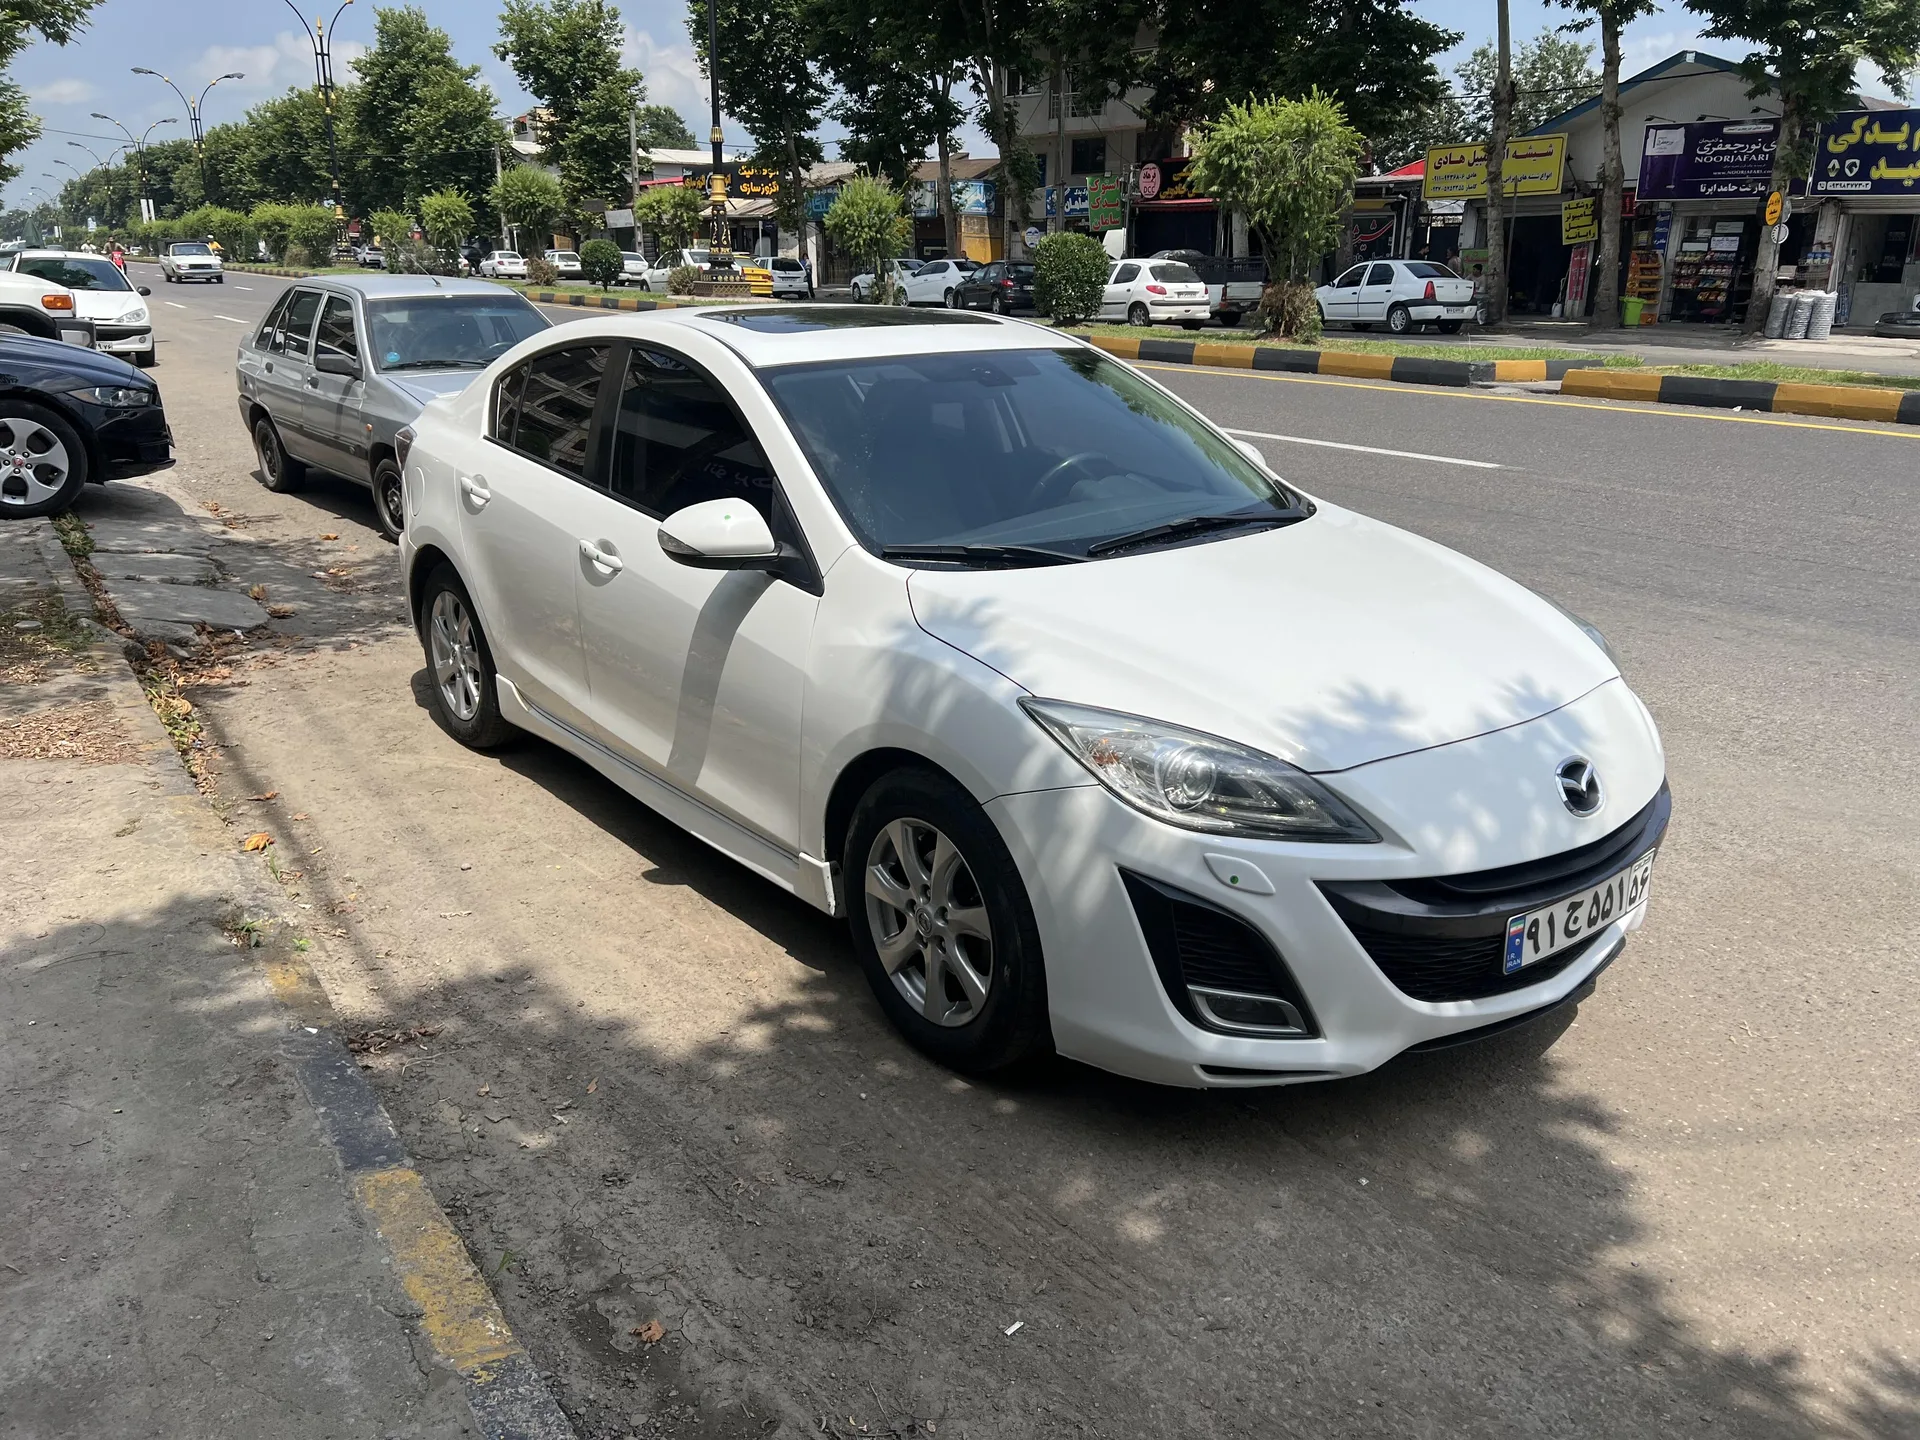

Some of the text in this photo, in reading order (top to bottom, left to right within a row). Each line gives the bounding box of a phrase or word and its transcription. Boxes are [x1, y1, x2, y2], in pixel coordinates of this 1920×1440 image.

[1827, 115, 1910, 154] یدکی
[1433, 143, 1554, 170] شیشه اتمبیل هادی
[1694, 153, 1769, 164] NOORJAFARI
[1089, 176, 1120, 194] استوک
[1143, 185, 1155, 194] DCC
[1717, 182, 1739, 192] حامد
[1090, 196, 1120, 211] یدک
[1092, 212, 1120, 231] سامان
[1565, 229, 1596, 240] رایانه
[1628, 866, 1649, 906] ۵۶
[1506, 958, 1521, 968] IRAN
